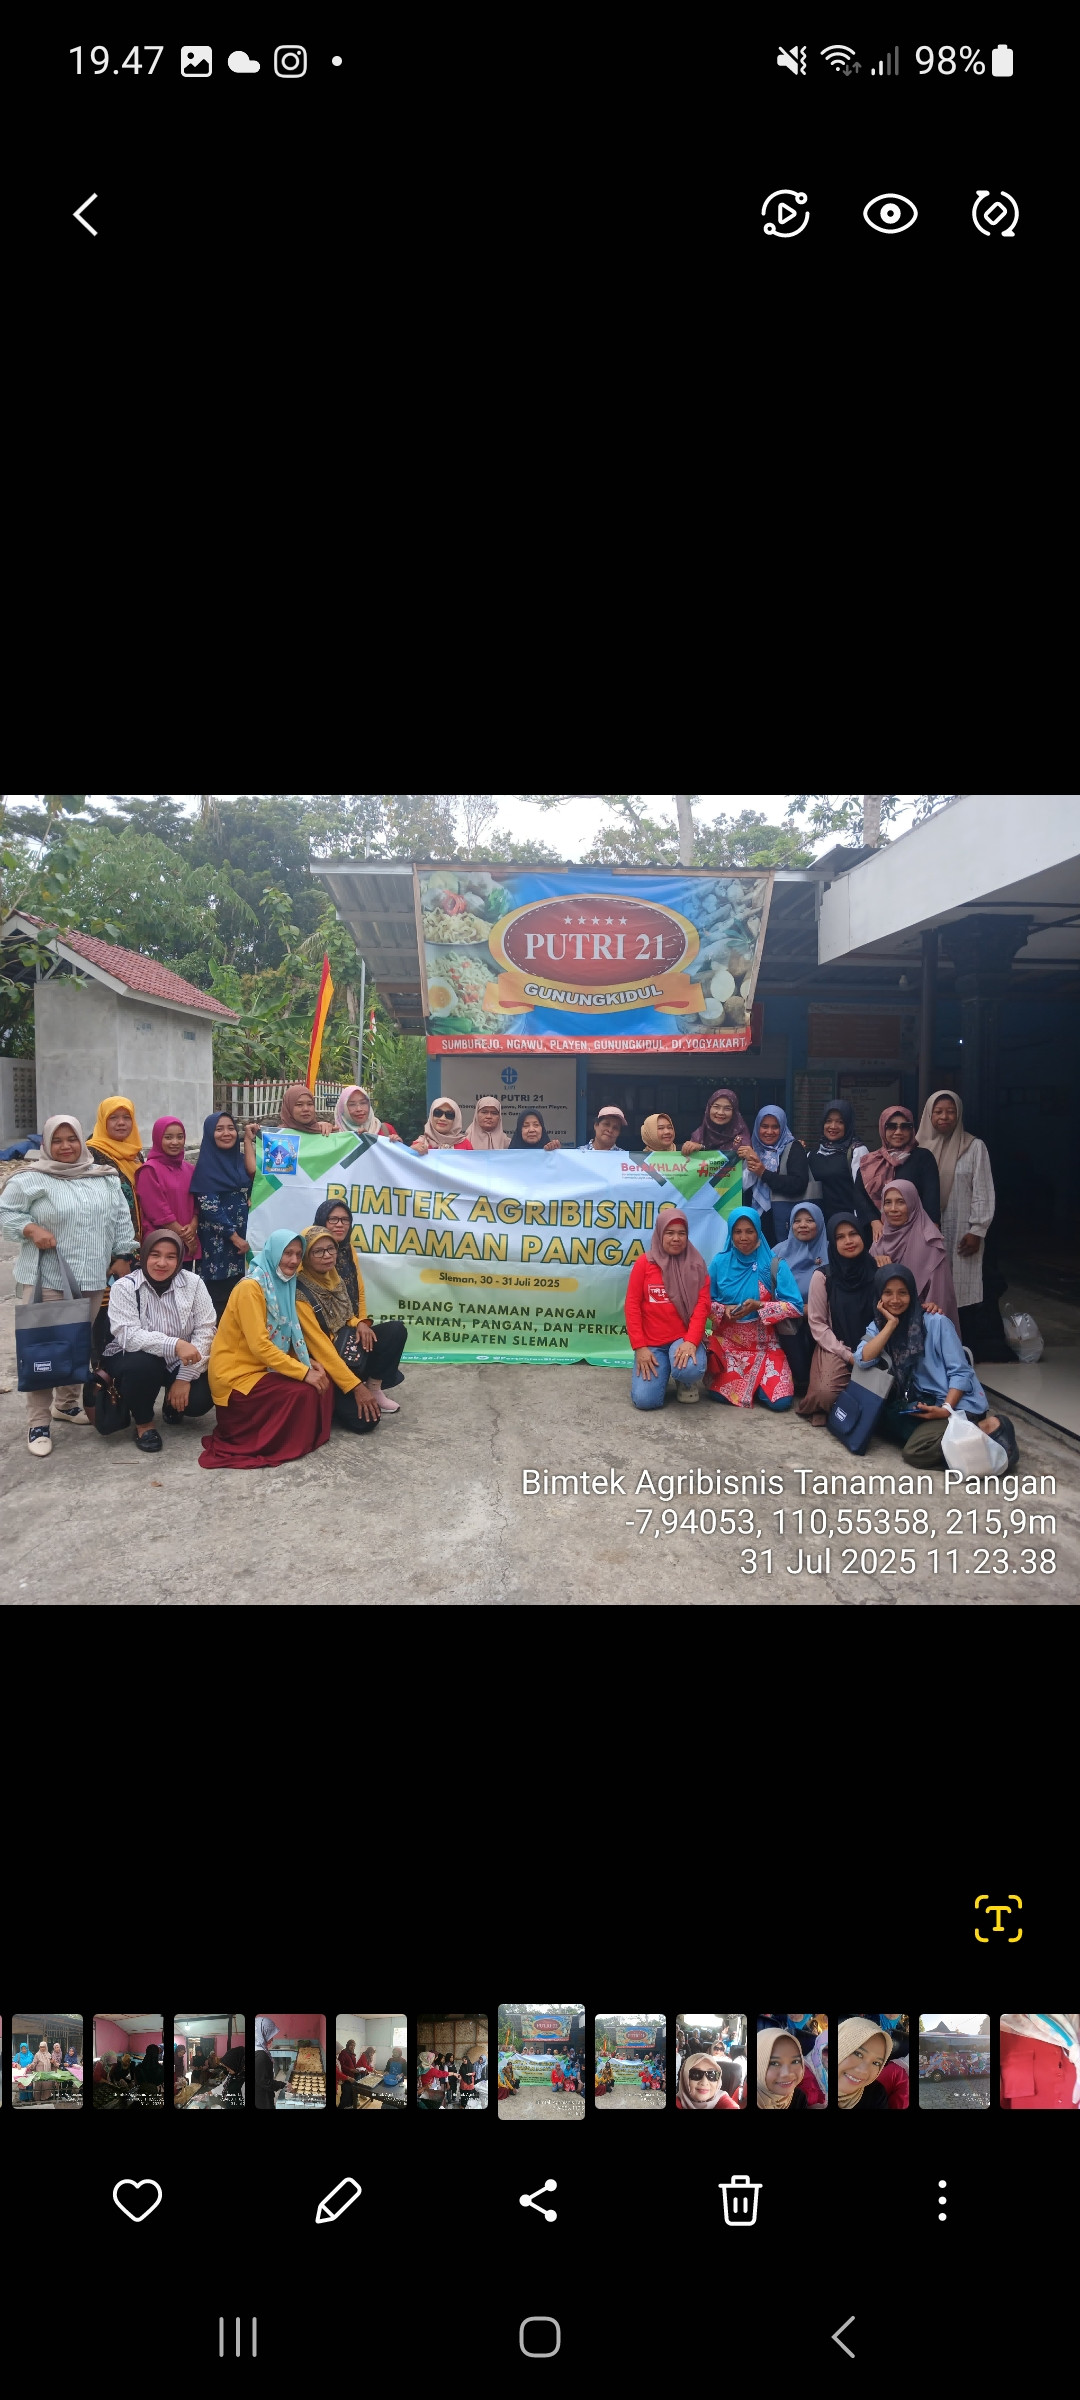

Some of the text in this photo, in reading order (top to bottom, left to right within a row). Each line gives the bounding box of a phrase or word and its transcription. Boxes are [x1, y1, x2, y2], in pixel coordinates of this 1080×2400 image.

[69, 45, 164, 75] 19.47
[915, 45, 986, 75] 98%
[524, 933, 665, 960] PUTRI 21
[524, 983, 663, 1007] GUNUNGKIDUL
[501, 1094, 530, 1102] PUTRI
[533, 1094, 544, 1102] 21
[327, 1183, 677, 1230] BIMTEK AGRIBISNI
[350, 1224, 646, 1267] ANAMAN PANGA
[438, 1272, 477, 1284] Sleman,
[480, 1275, 493, 1285] 30
[502, 1276, 512, 1286] 31
[514, 1277, 531, 1287] Juli
[533, 1278, 560, 1288] 2025
[398, 1299, 596, 1319] BIDANG TANAMAN PANGAN
[472, 1318, 537, 1333] PANGAN,
[543, 1322, 573, 1333] DAN
[578, 1323, 628, 1336] PERIKA
[422, 1331, 569, 1348] KABUPATEN SLEMAN
